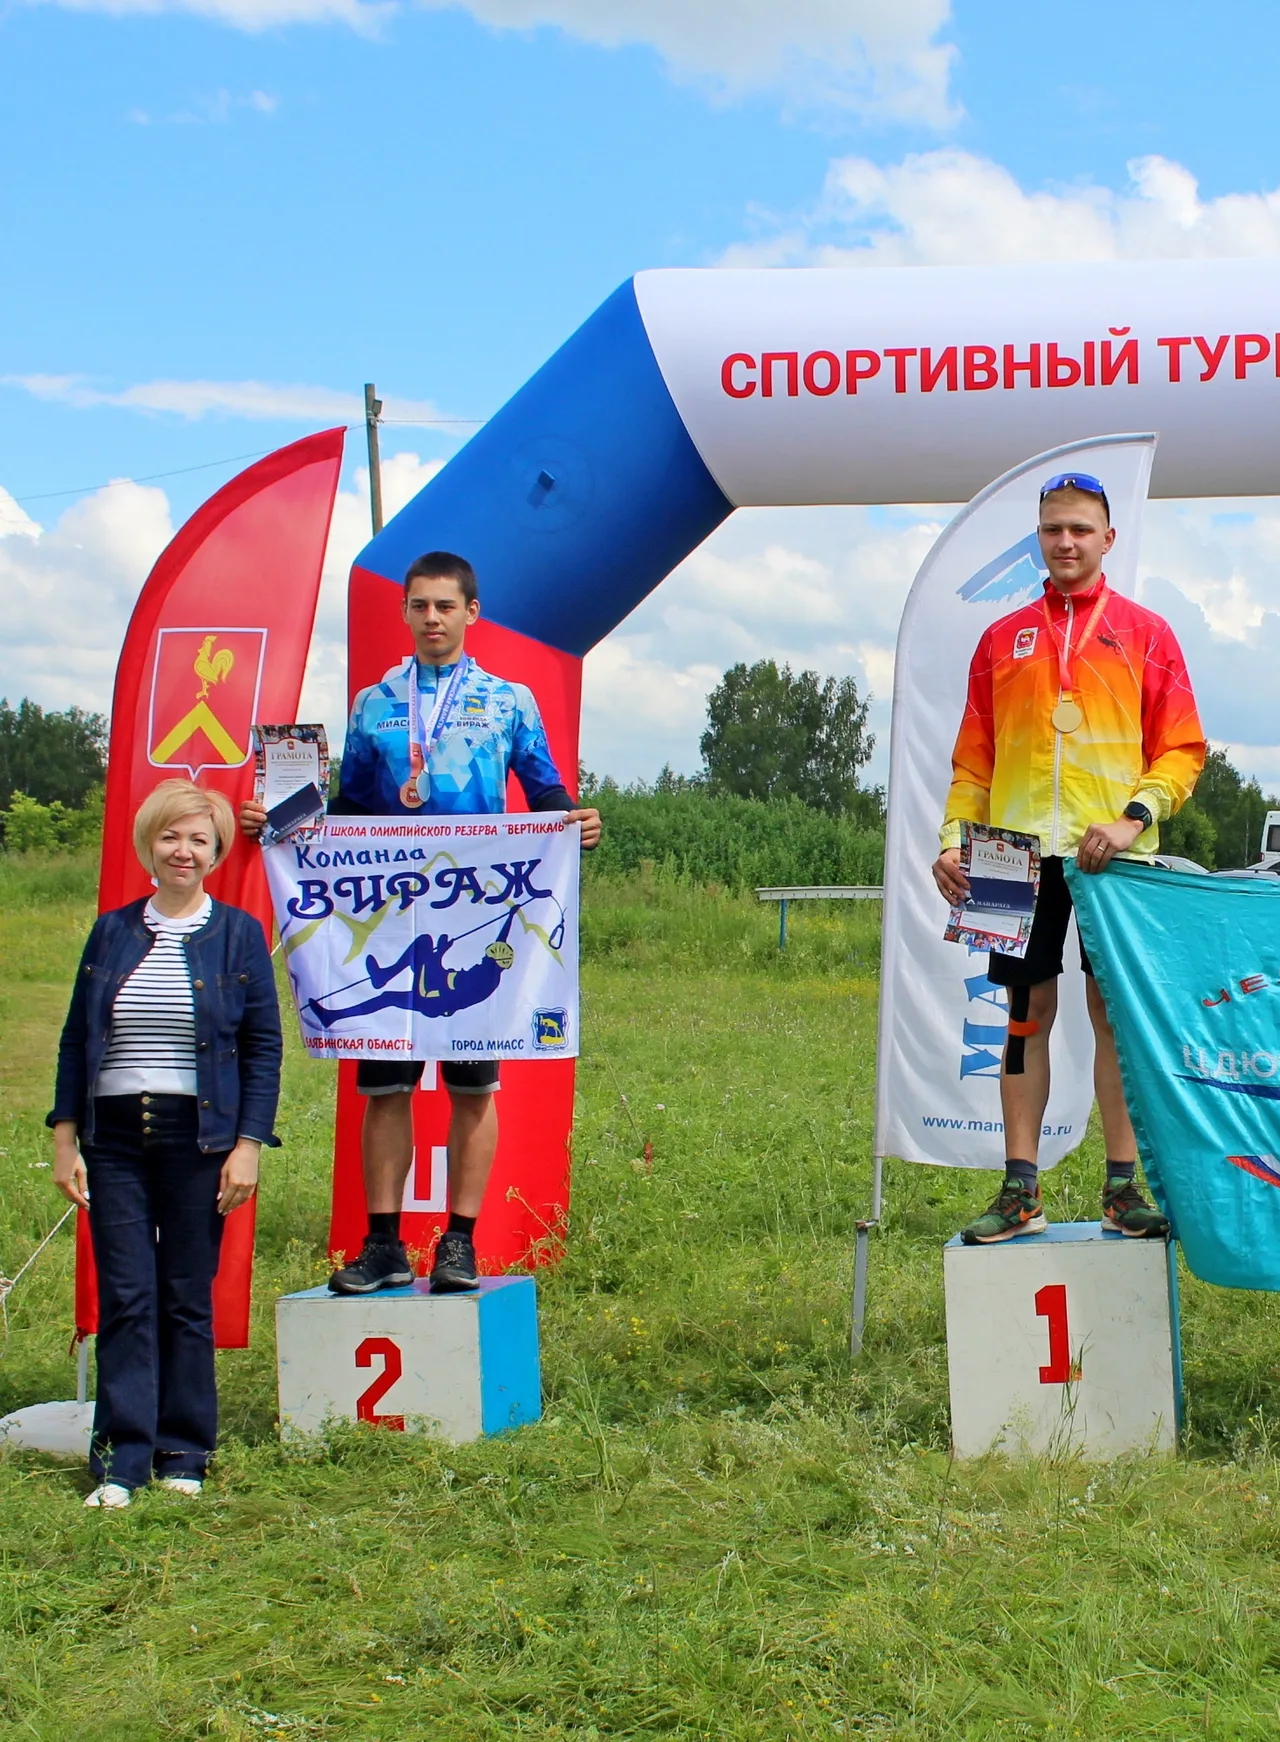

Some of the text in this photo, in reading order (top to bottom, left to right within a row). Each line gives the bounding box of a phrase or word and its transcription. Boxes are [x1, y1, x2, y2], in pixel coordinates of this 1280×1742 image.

[721, 327, 1139, 399] СПОРТИВНЫЙ
[457, 721, 490, 729] ВИРАЖ
[271, 751, 313, 760] ГРАМОТА
[330, 826, 367, 837] ШКОЛА
[370, 824, 451, 837] ОЛИМПИЙСКОГО
[454, 824, 498, 836] РЕЗЕРВА
[295, 845, 427, 869] Команда
[977, 850, 1023, 866] ГРАМОТА
[287, 858, 552, 920] ВИРАЖ
[367, 1038, 413, 1051] ОБЛАСТЬ
[452, 1038, 525, 1051] ГОРОД МИАСС
[1035, 1284, 1082, 1385] 1
[355, 1337, 405, 1432] 2
